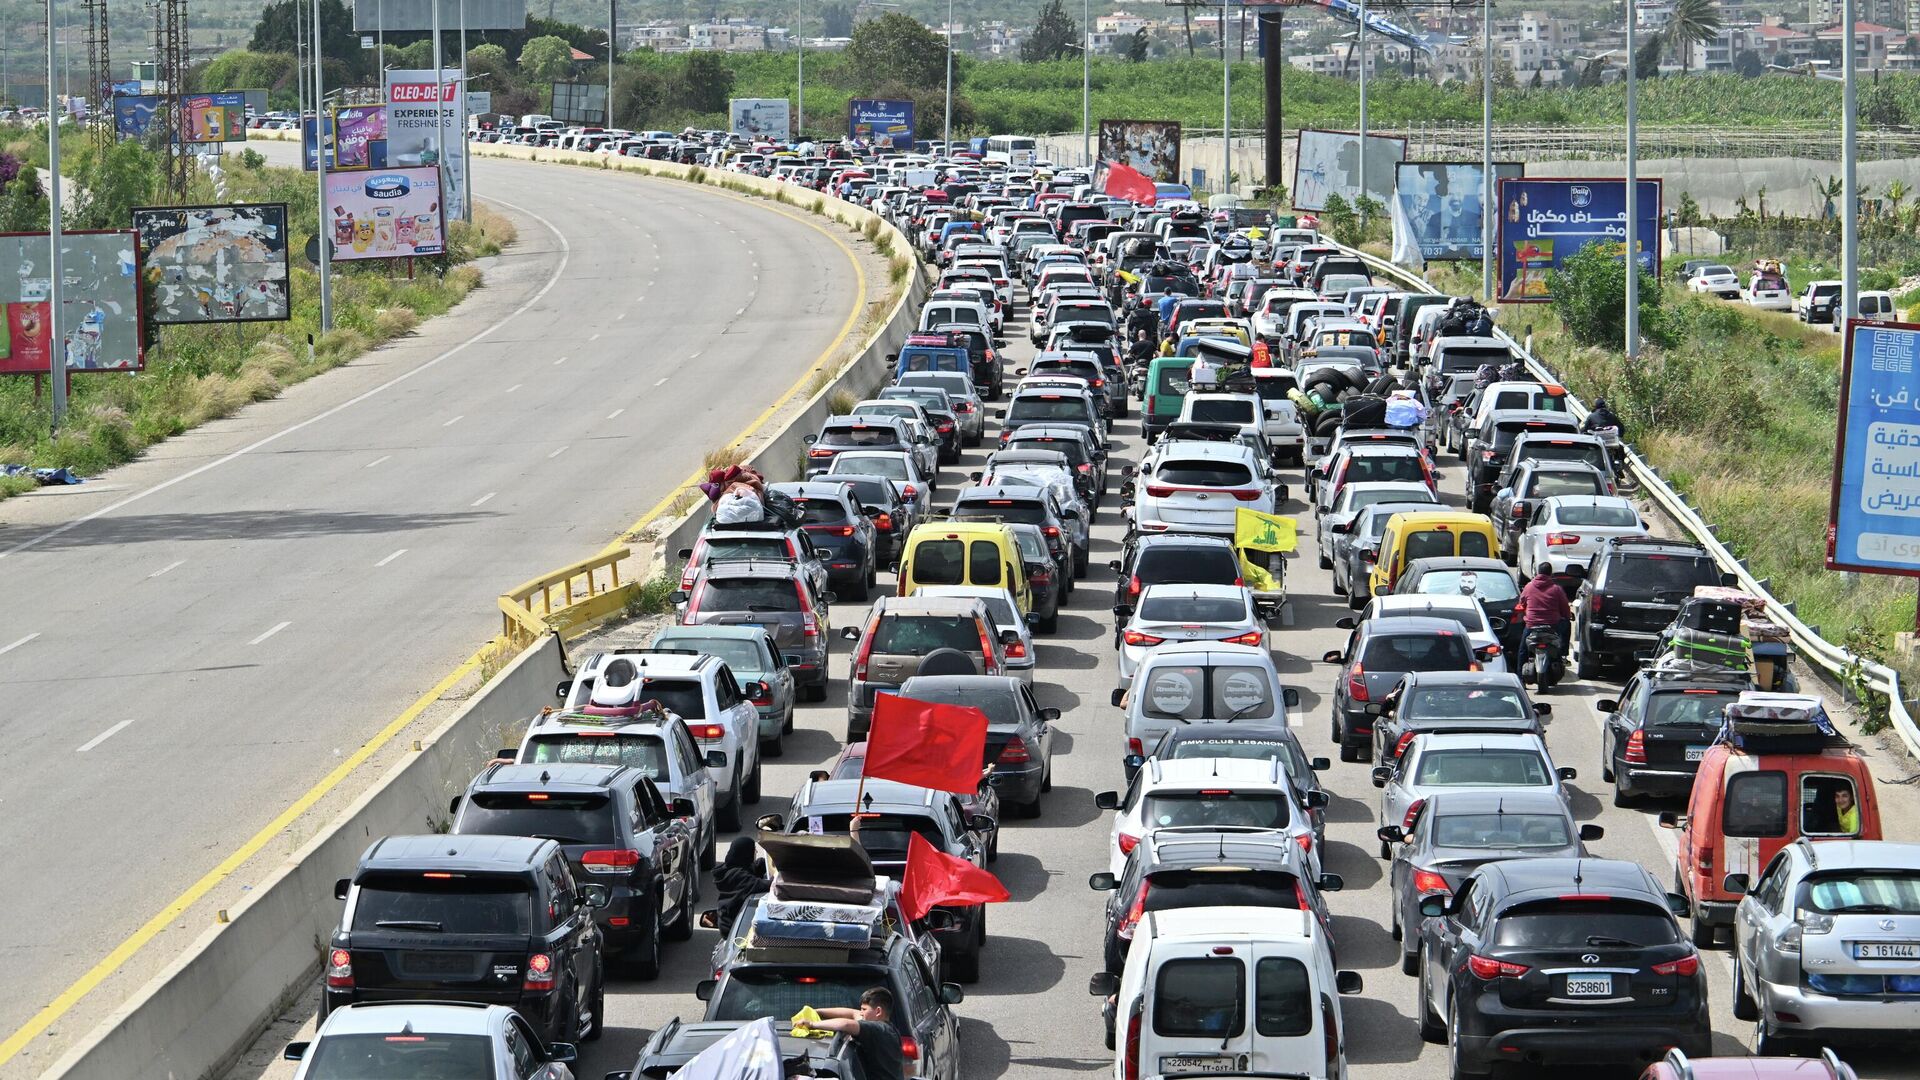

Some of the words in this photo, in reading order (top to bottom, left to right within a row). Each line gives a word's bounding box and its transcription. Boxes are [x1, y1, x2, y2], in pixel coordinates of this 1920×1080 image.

[398, 119, 451, 128] FRESHNES
[373, 189, 402, 197] saudia
[160, 219, 176, 227] The
[1872, 457, 1920, 480] اسبة
[1686, 750, 1705, 760] G671
[1862, 945, 1869, 957] S
[1876, 945, 1913, 957] 161444
[1567, 981, 1611, 994] S258601
